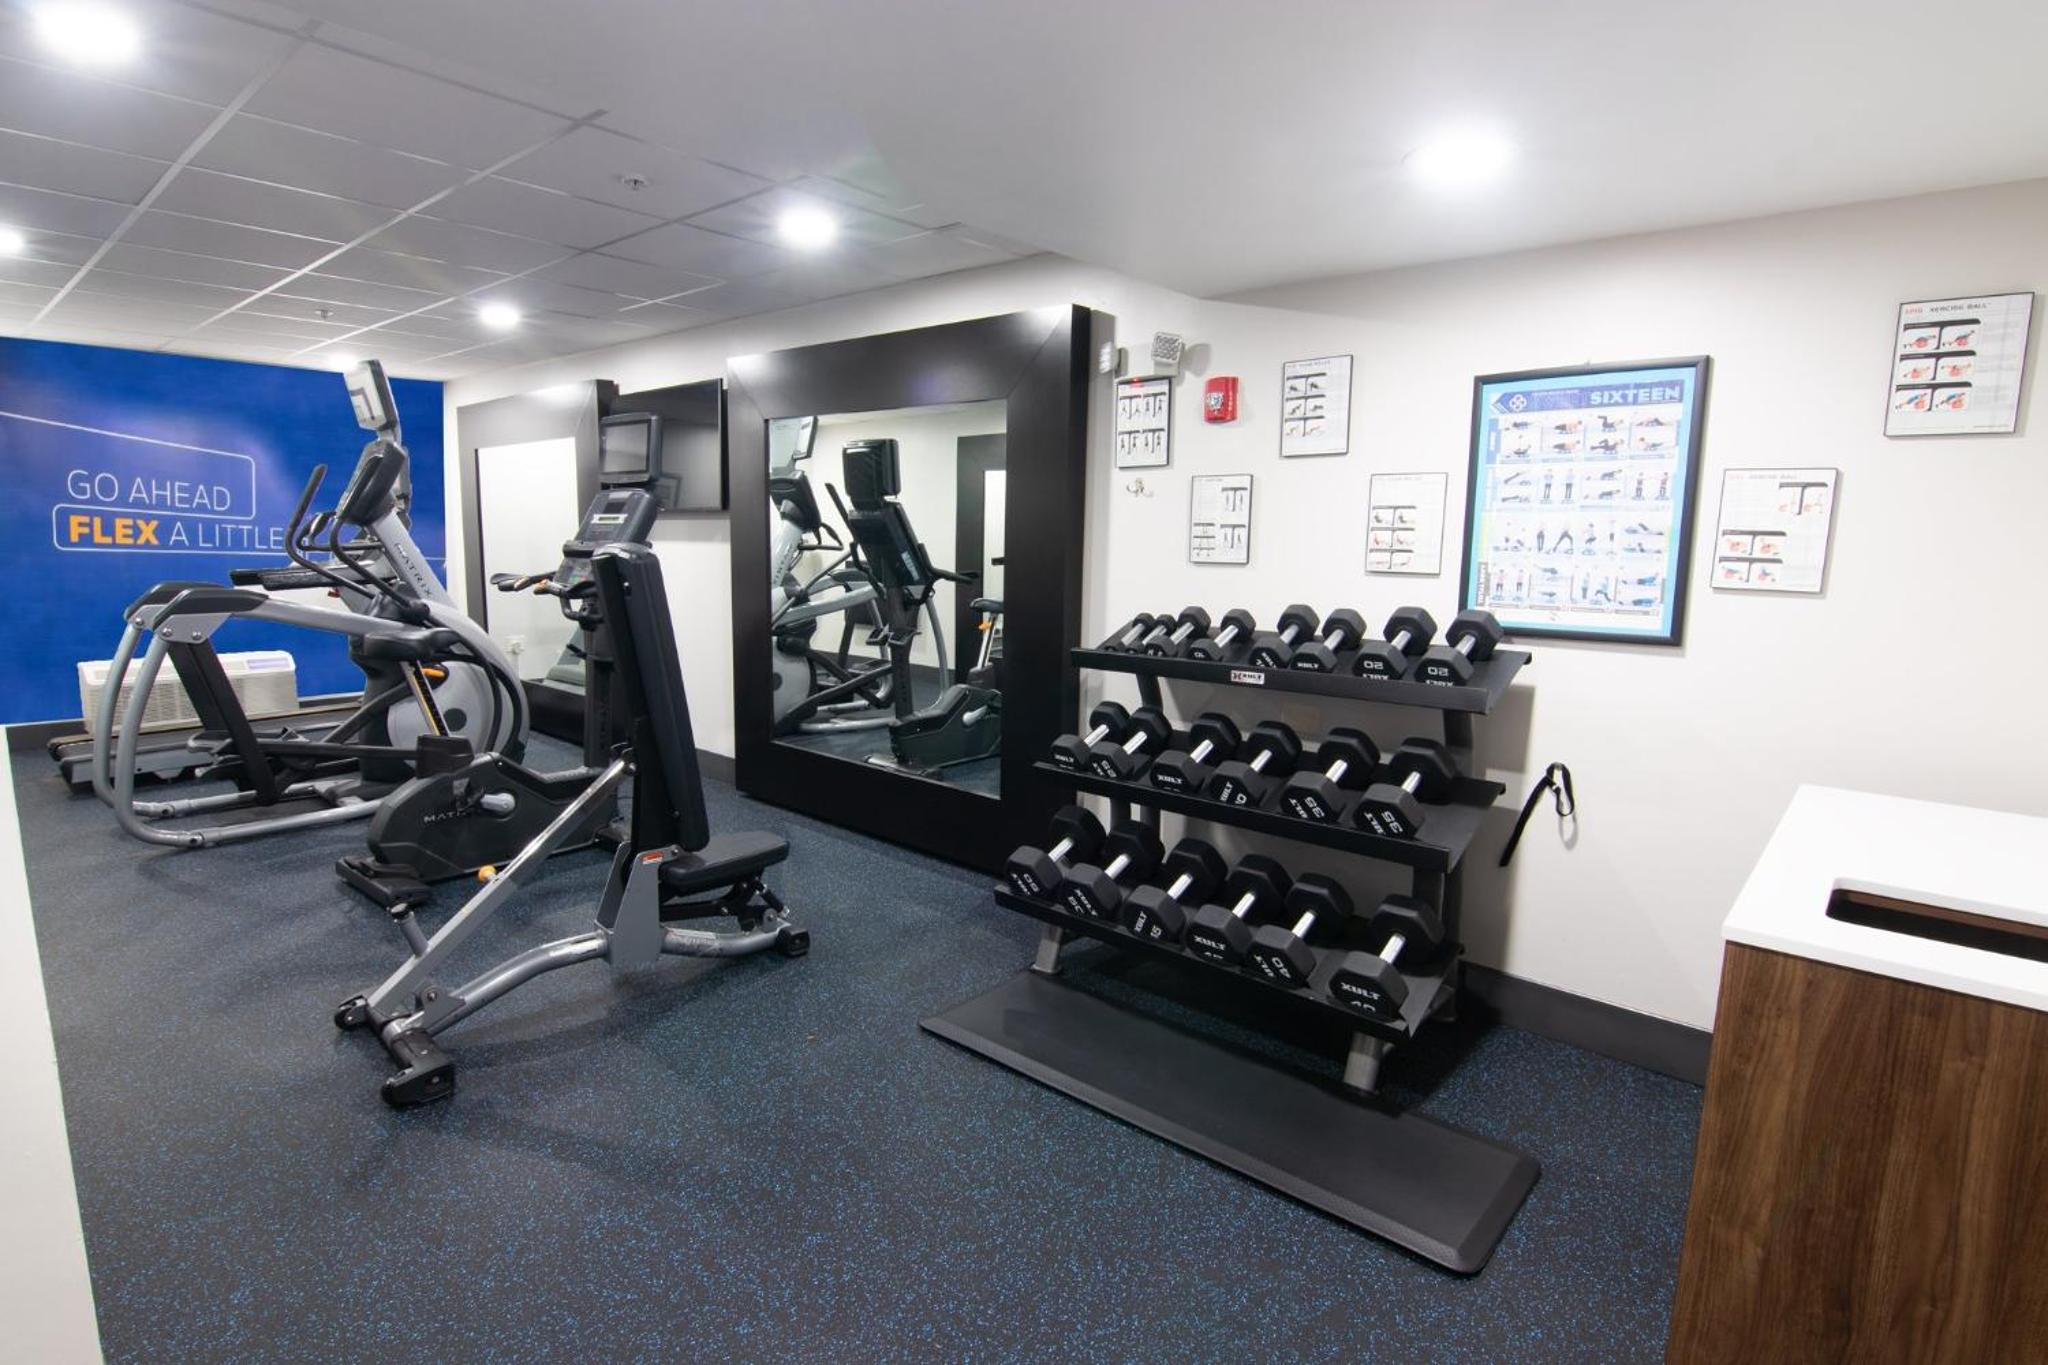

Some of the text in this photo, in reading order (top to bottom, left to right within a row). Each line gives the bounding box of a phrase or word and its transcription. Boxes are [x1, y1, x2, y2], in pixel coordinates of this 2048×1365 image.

[1590, 386, 1680, 406] SIXTEEN
[67, 469, 231, 512] GO AHEAD
[69, 515, 284, 550] FLEX A LITTLE
[1304, 796, 1326, 819] 35
[1381, 811, 1404, 834] 35
[1193, 934, 1227, 951] XULT
[1340, 982, 1381, 1000] XULT
